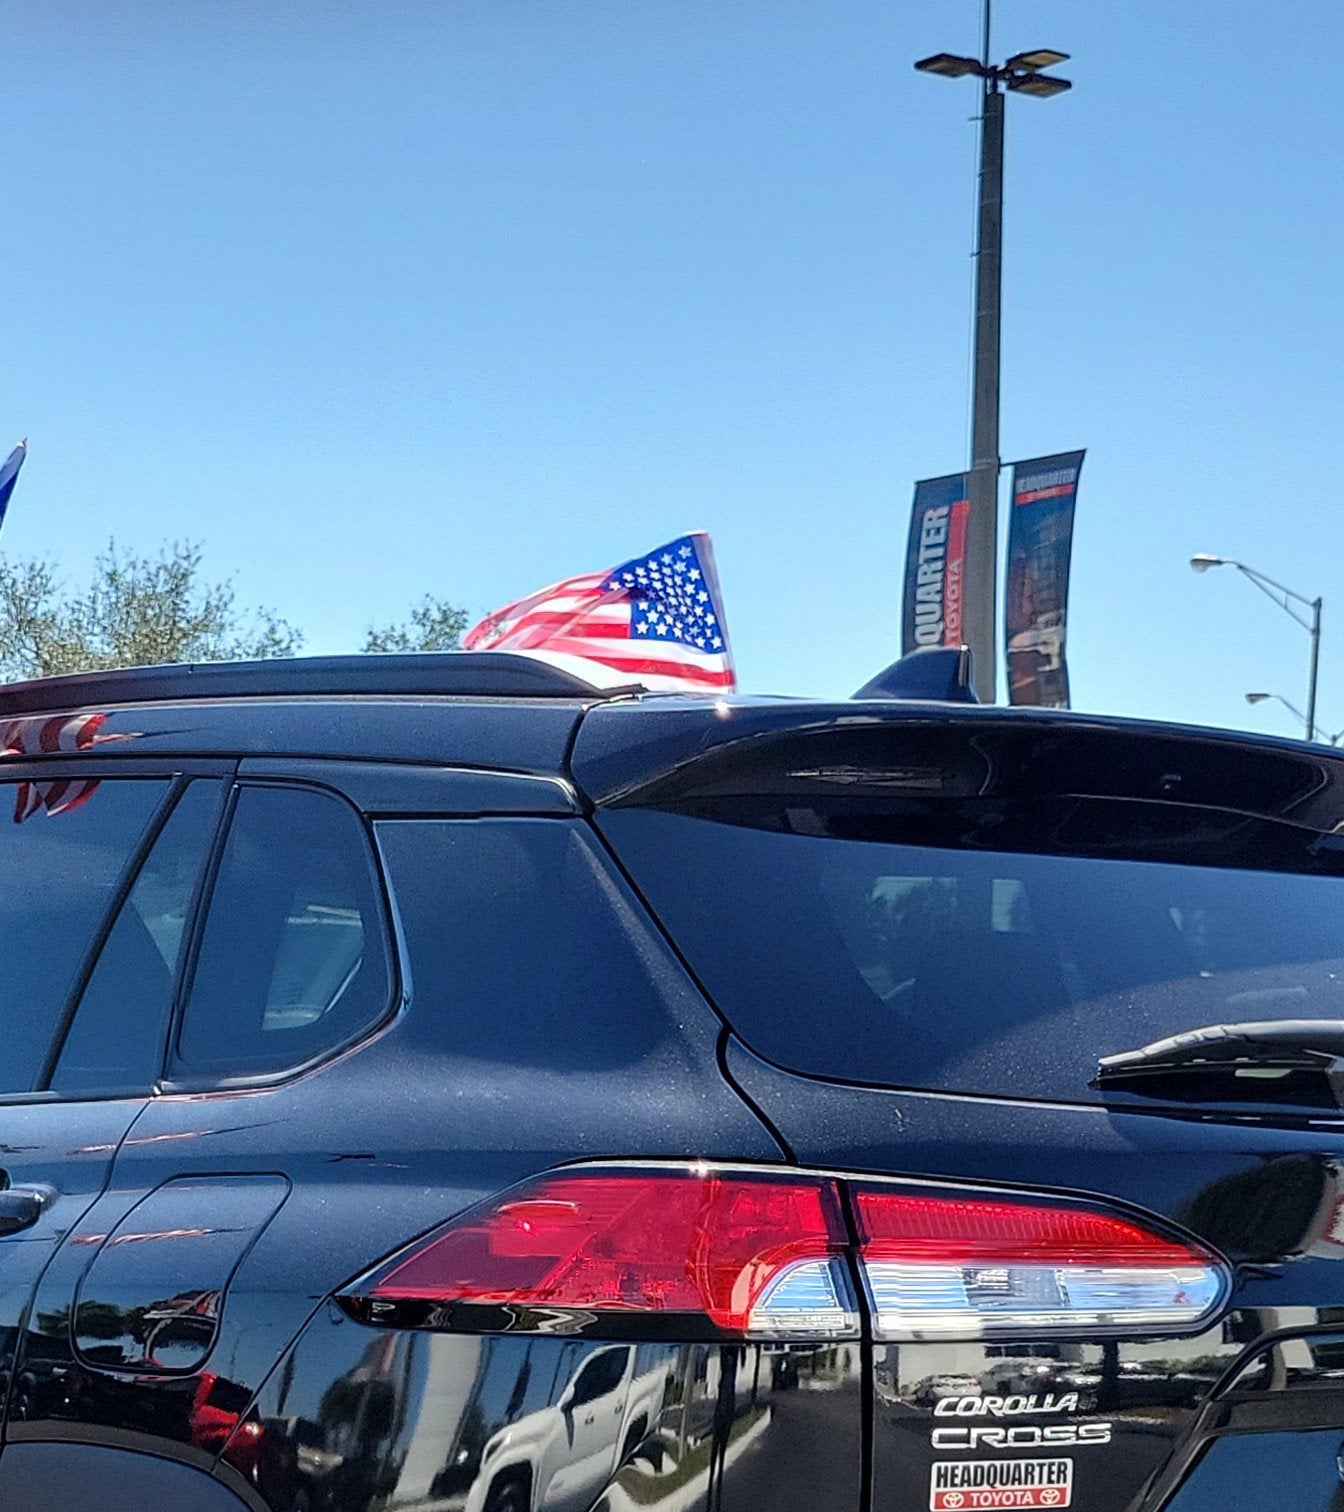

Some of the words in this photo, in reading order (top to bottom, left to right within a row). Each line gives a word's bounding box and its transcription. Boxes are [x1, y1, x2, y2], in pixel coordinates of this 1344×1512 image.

[945, 558, 962, 644] TOYOTA
[933, 1392, 1079, 1417] COROLLA
[931, 1423, 1112, 1449] CROSS
[936, 1461, 1068, 1489] HEADQUARTER
[970, 1491, 1035, 1506] TOYOTA
